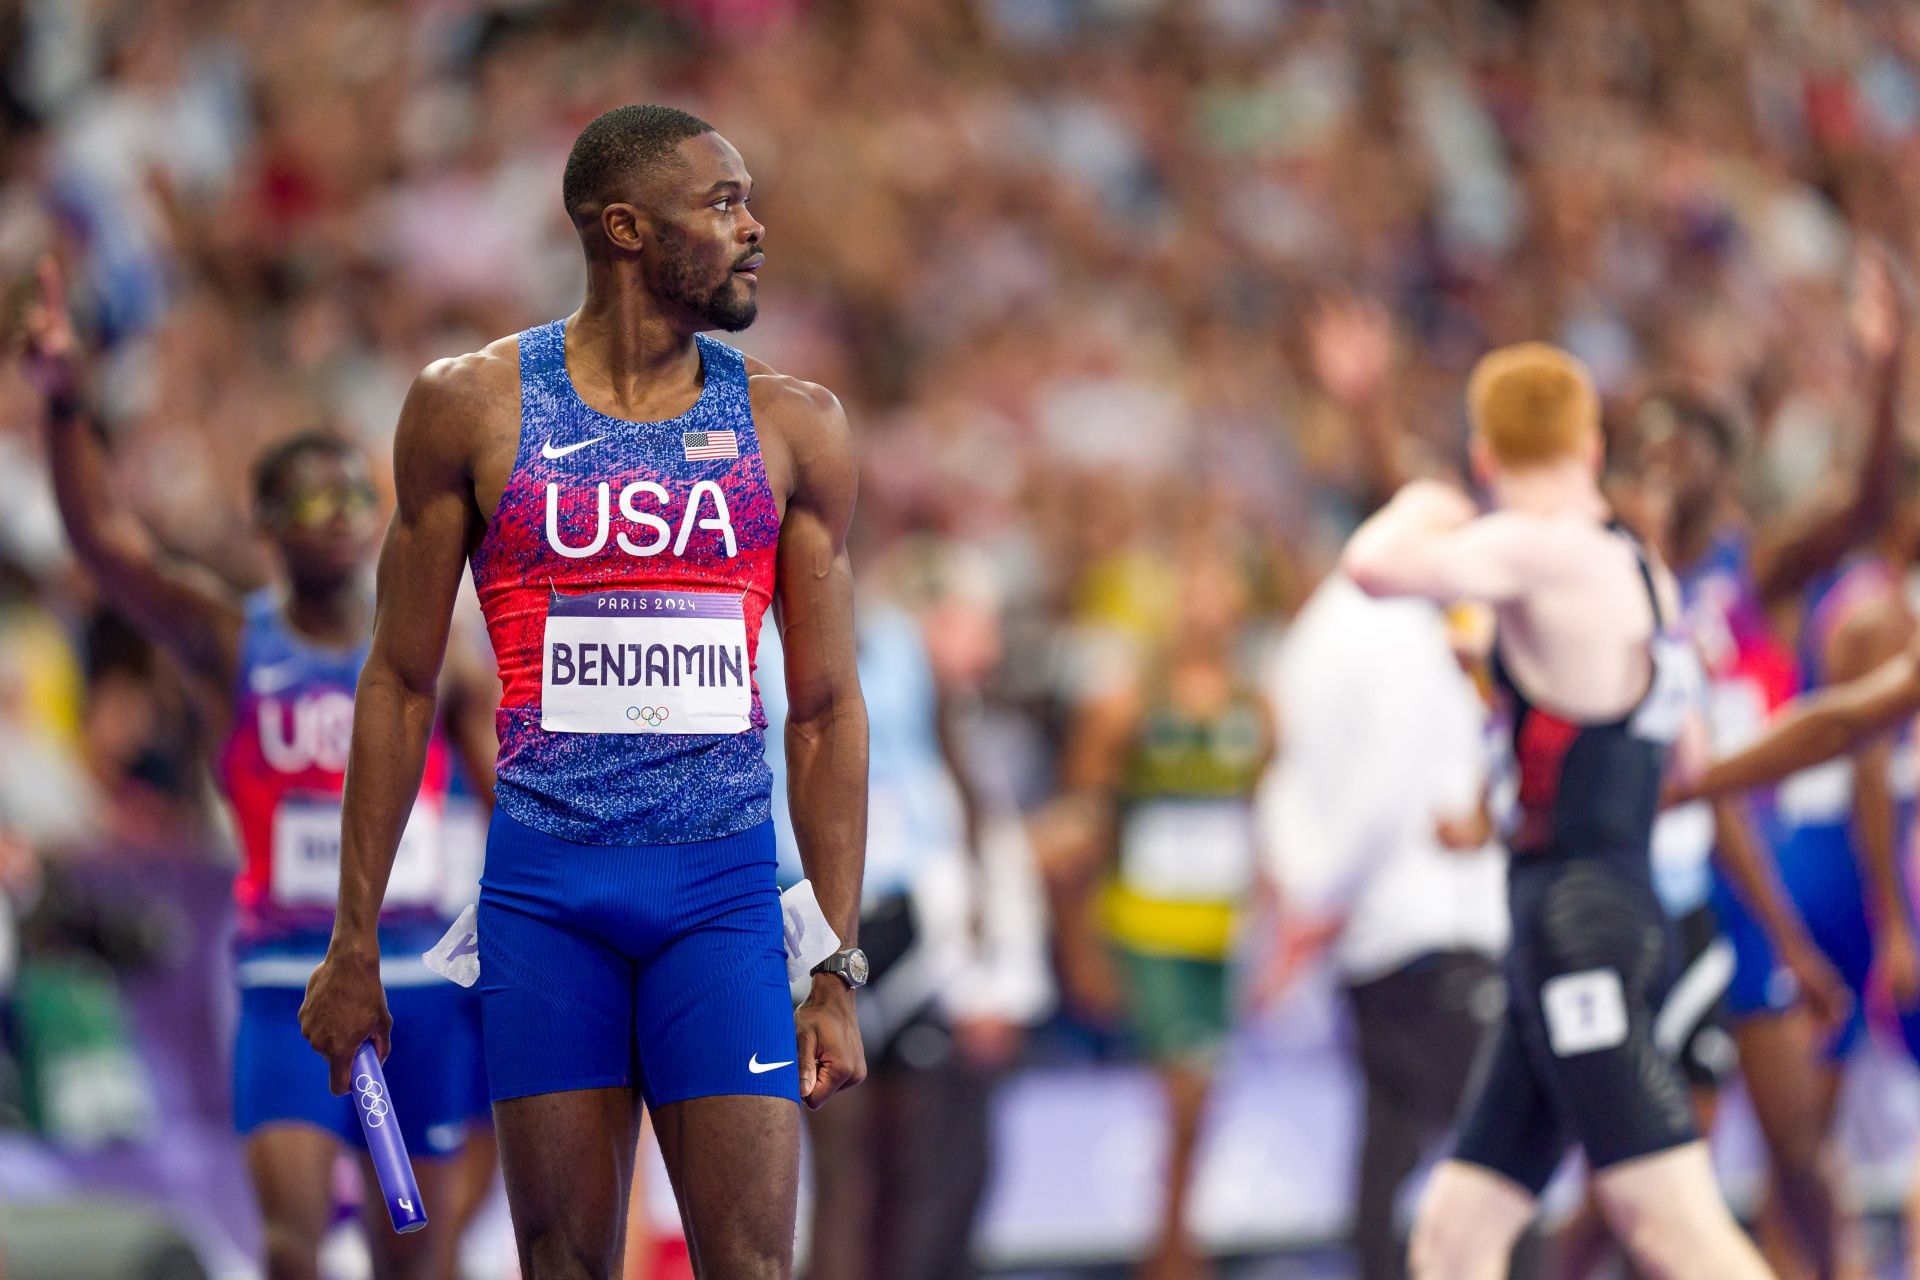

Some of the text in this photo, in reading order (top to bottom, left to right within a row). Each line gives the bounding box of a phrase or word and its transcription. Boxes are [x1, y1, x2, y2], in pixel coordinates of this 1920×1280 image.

[546, 480, 738, 558] USA
[654, 598, 696, 611] 2024
[551, 642, 743, 687] BENJAMIN
[257, 692, 355, 774] US
